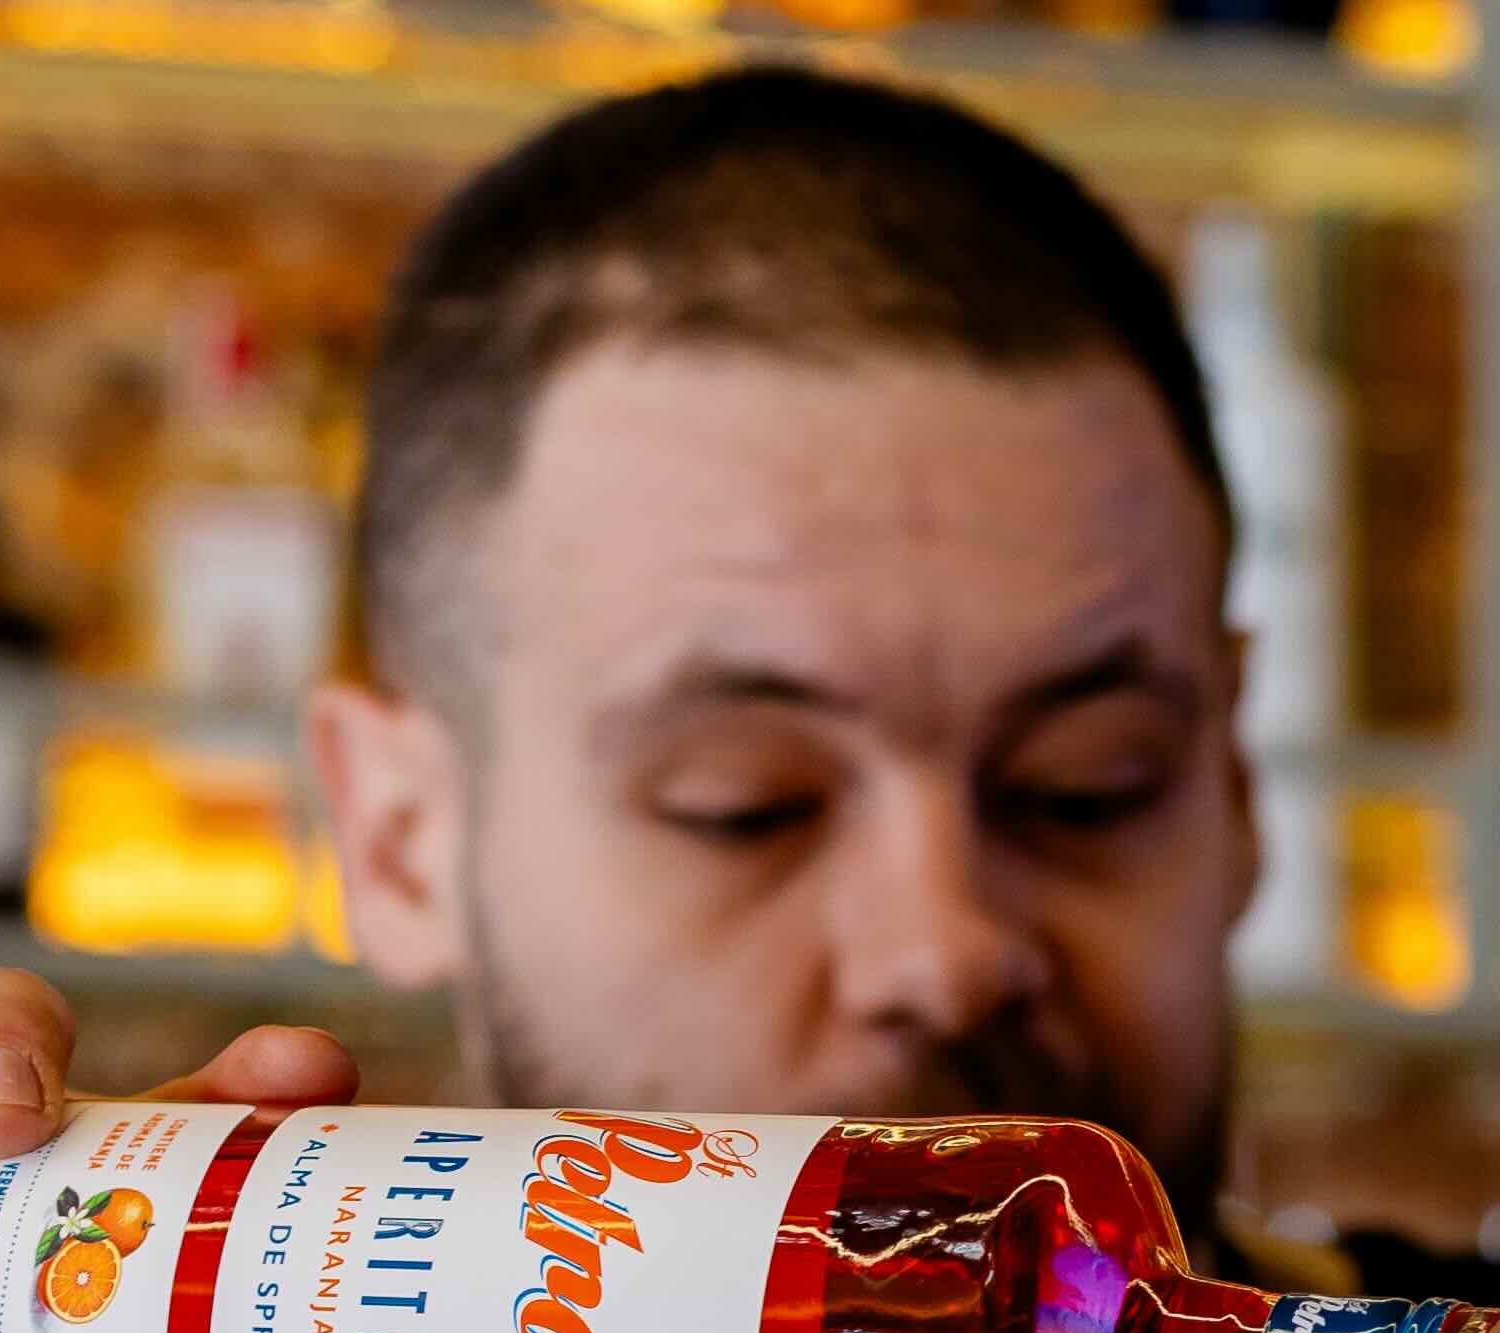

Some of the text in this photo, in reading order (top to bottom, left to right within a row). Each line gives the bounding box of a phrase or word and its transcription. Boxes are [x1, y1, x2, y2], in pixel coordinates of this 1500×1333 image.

[115, 1154, 134, 1170] DE
[276, 1138, 328, 1210] ALMA
[695, 1127, 760, 1179] St
[262, 1225, 293, 1265] DE
